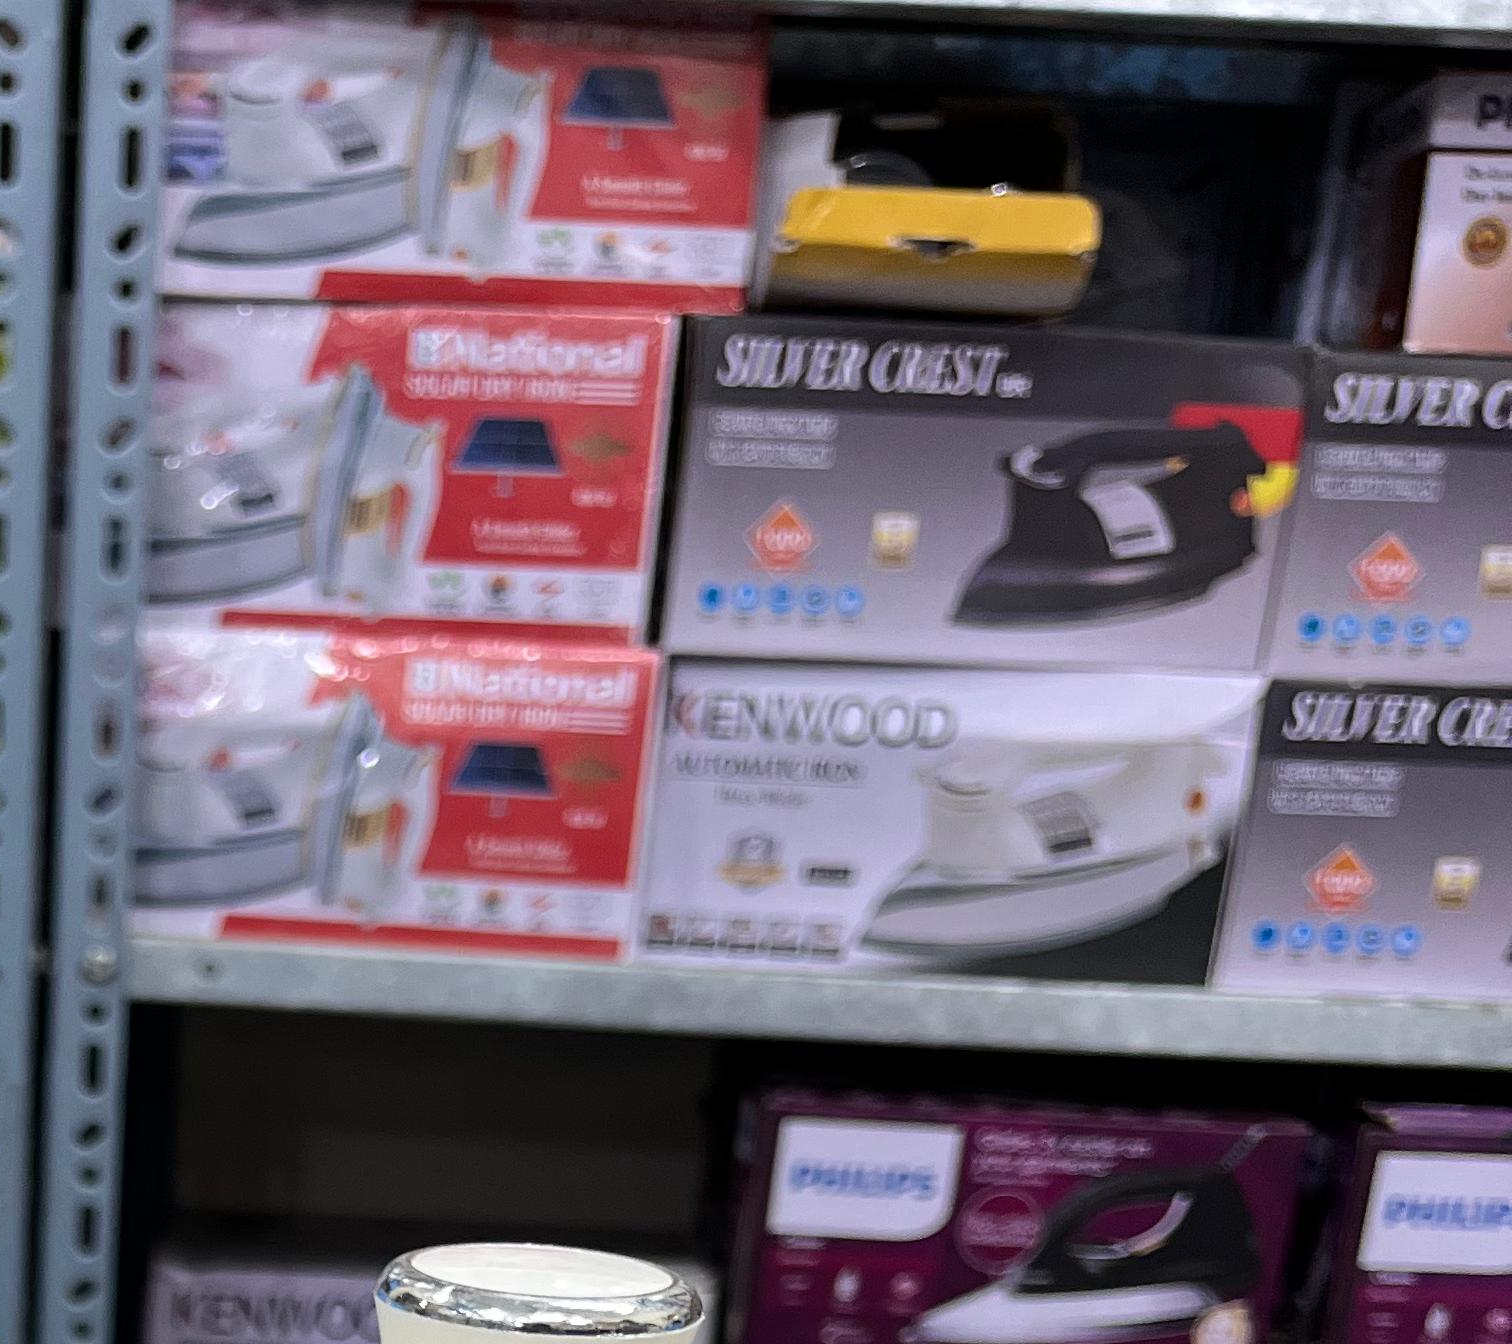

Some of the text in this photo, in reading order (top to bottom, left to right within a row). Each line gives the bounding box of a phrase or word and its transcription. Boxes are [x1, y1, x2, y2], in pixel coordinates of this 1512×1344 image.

[716, 333, 870, 392] SILVER
[868, 340, 1011, 397] CREST
[1323, 371, 1481, 427] SILVER
[666, 690, 960, 749] KENWOOD
[1281, 690, 1512, 749] SILVER CRE
